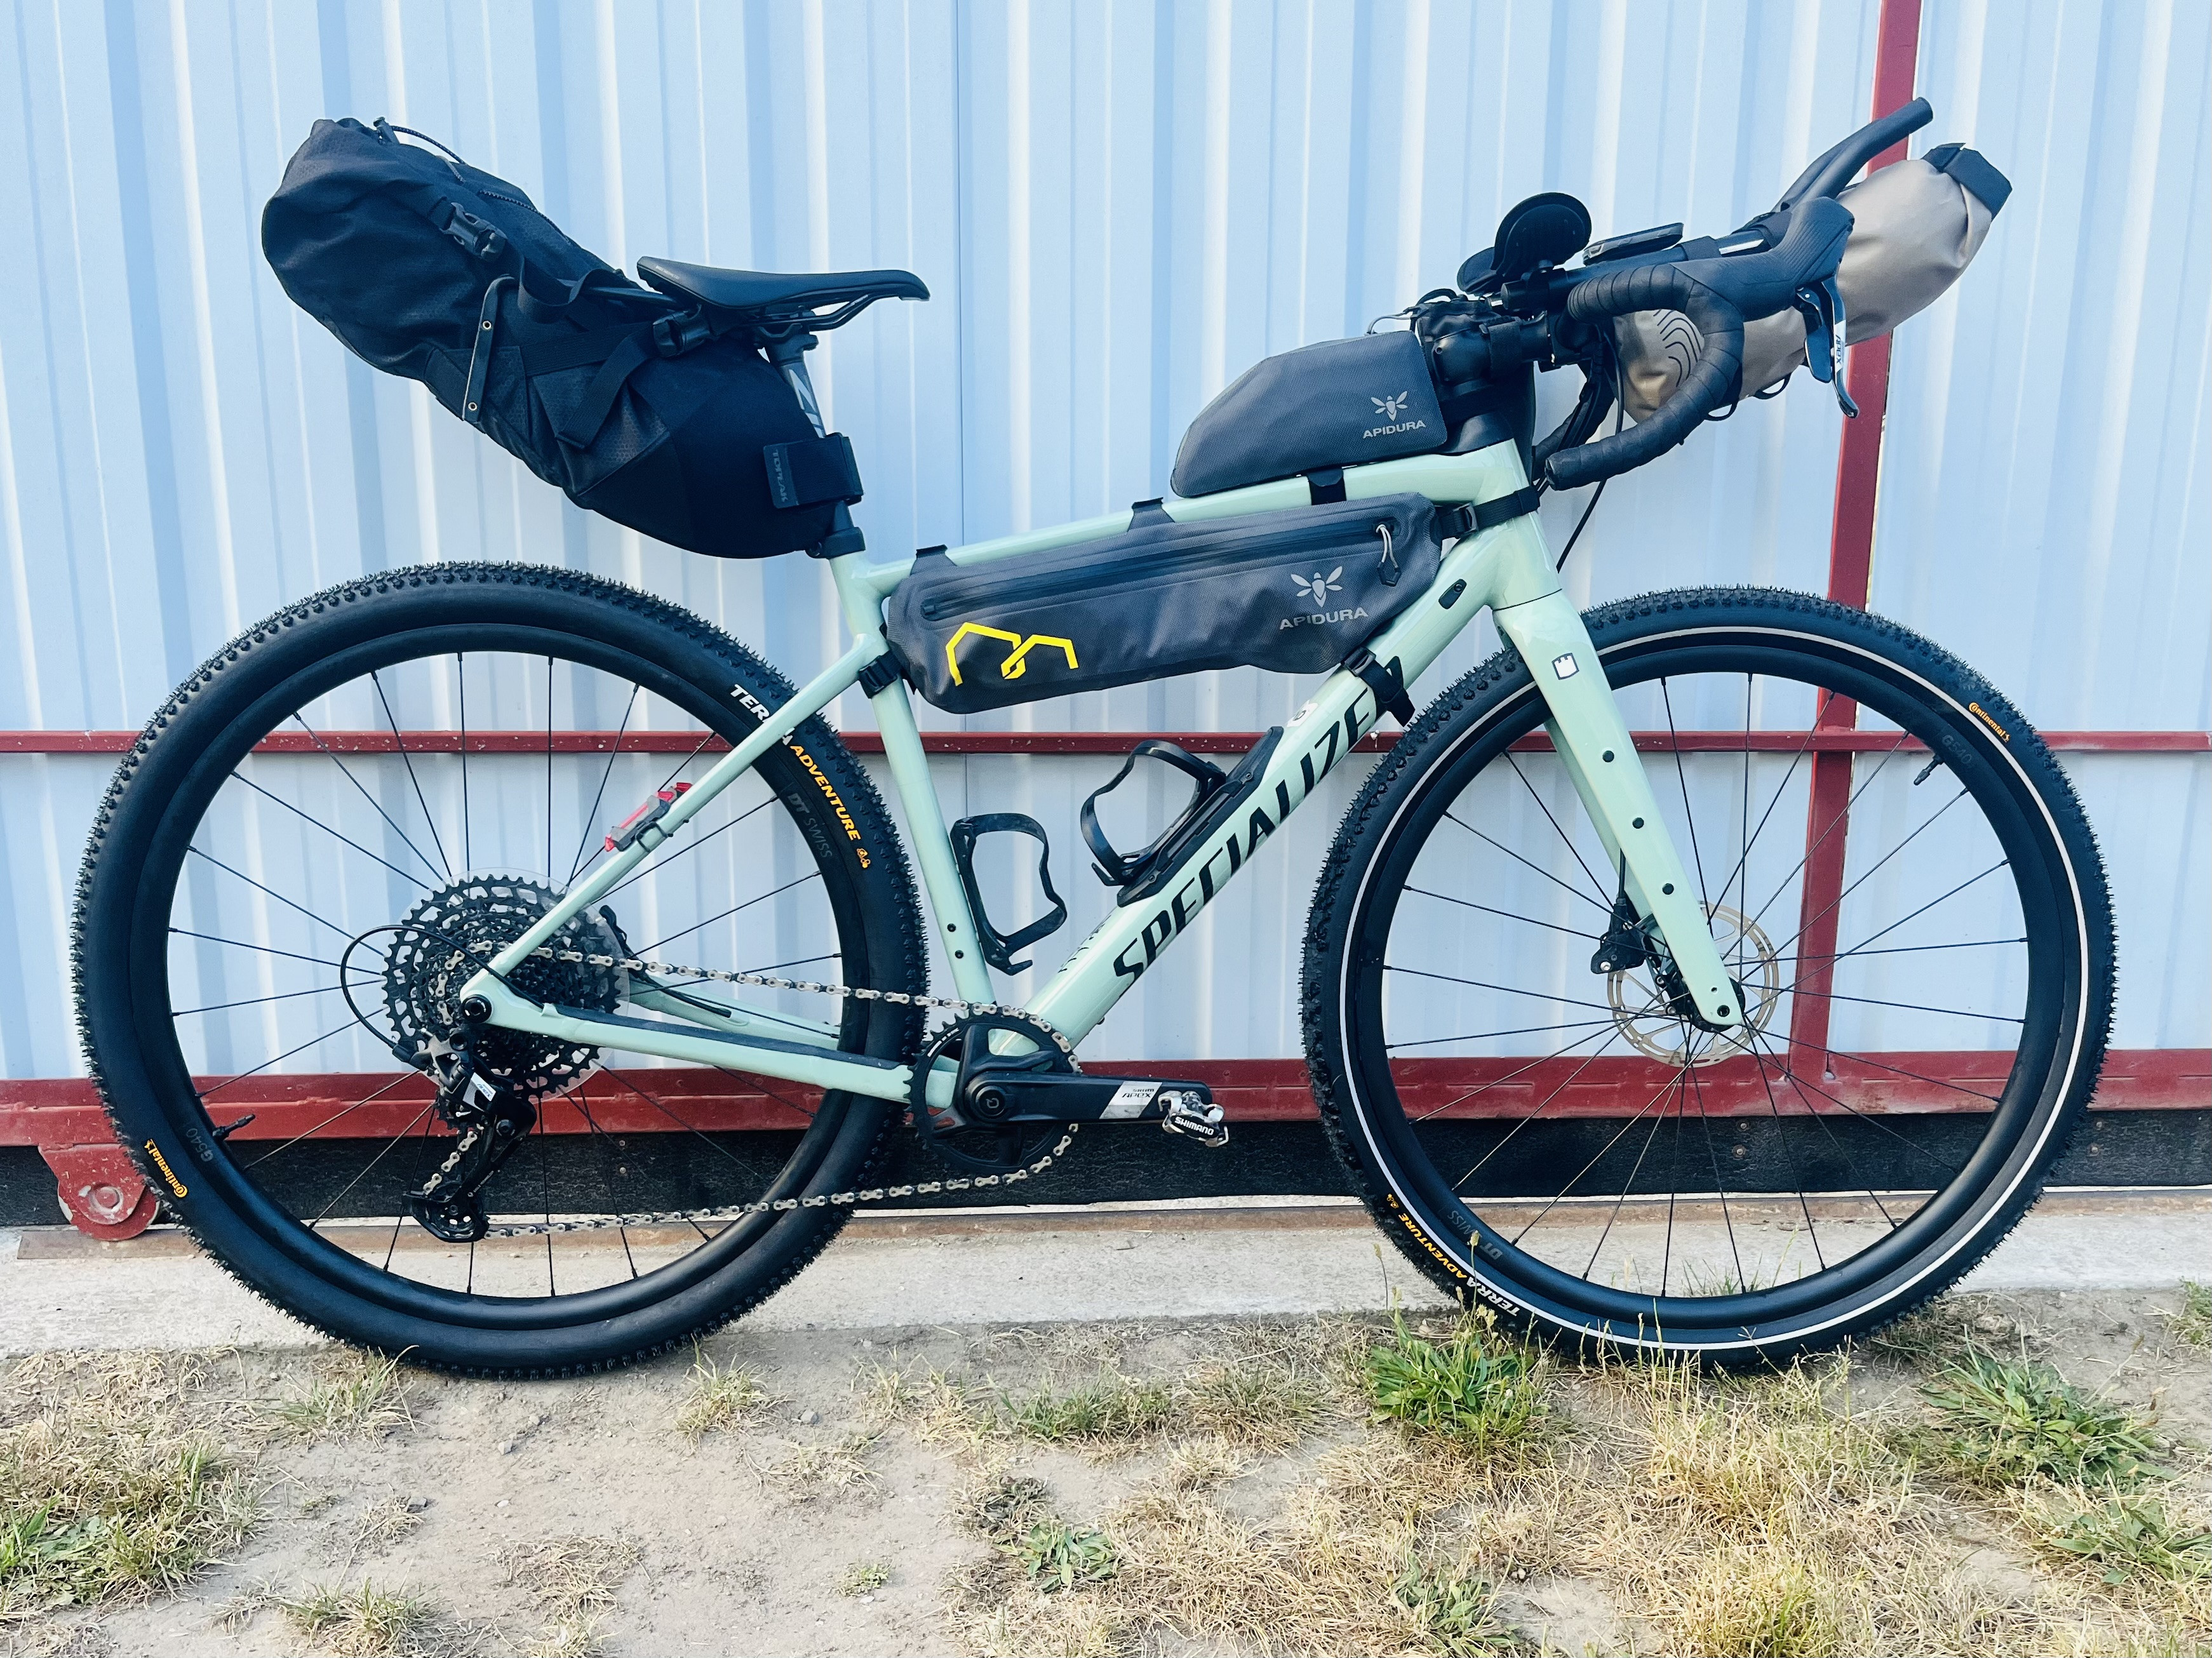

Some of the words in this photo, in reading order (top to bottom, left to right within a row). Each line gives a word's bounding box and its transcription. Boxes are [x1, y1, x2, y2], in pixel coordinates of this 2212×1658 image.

[1362, 420, 1426, 439] APIDURA
[1279, 607, 1369, 630] APIDURA
[1969, 702, 2006, 739] Continental
[789, 745, 861, 841] ADVENTURE
[787, 793, 810, 813] DT
[803, 817, 833, 858] SWISS
[1175, 1116, 1214, 1135] SHIMANO
[149, 1144, 188, 1198] Continental
[1447, 1210, 1483, 1242] WISS
[1398, 1213, 1468, 1279] ADVENTURE
[1466, 1276, 1522, 1317] TERRA
